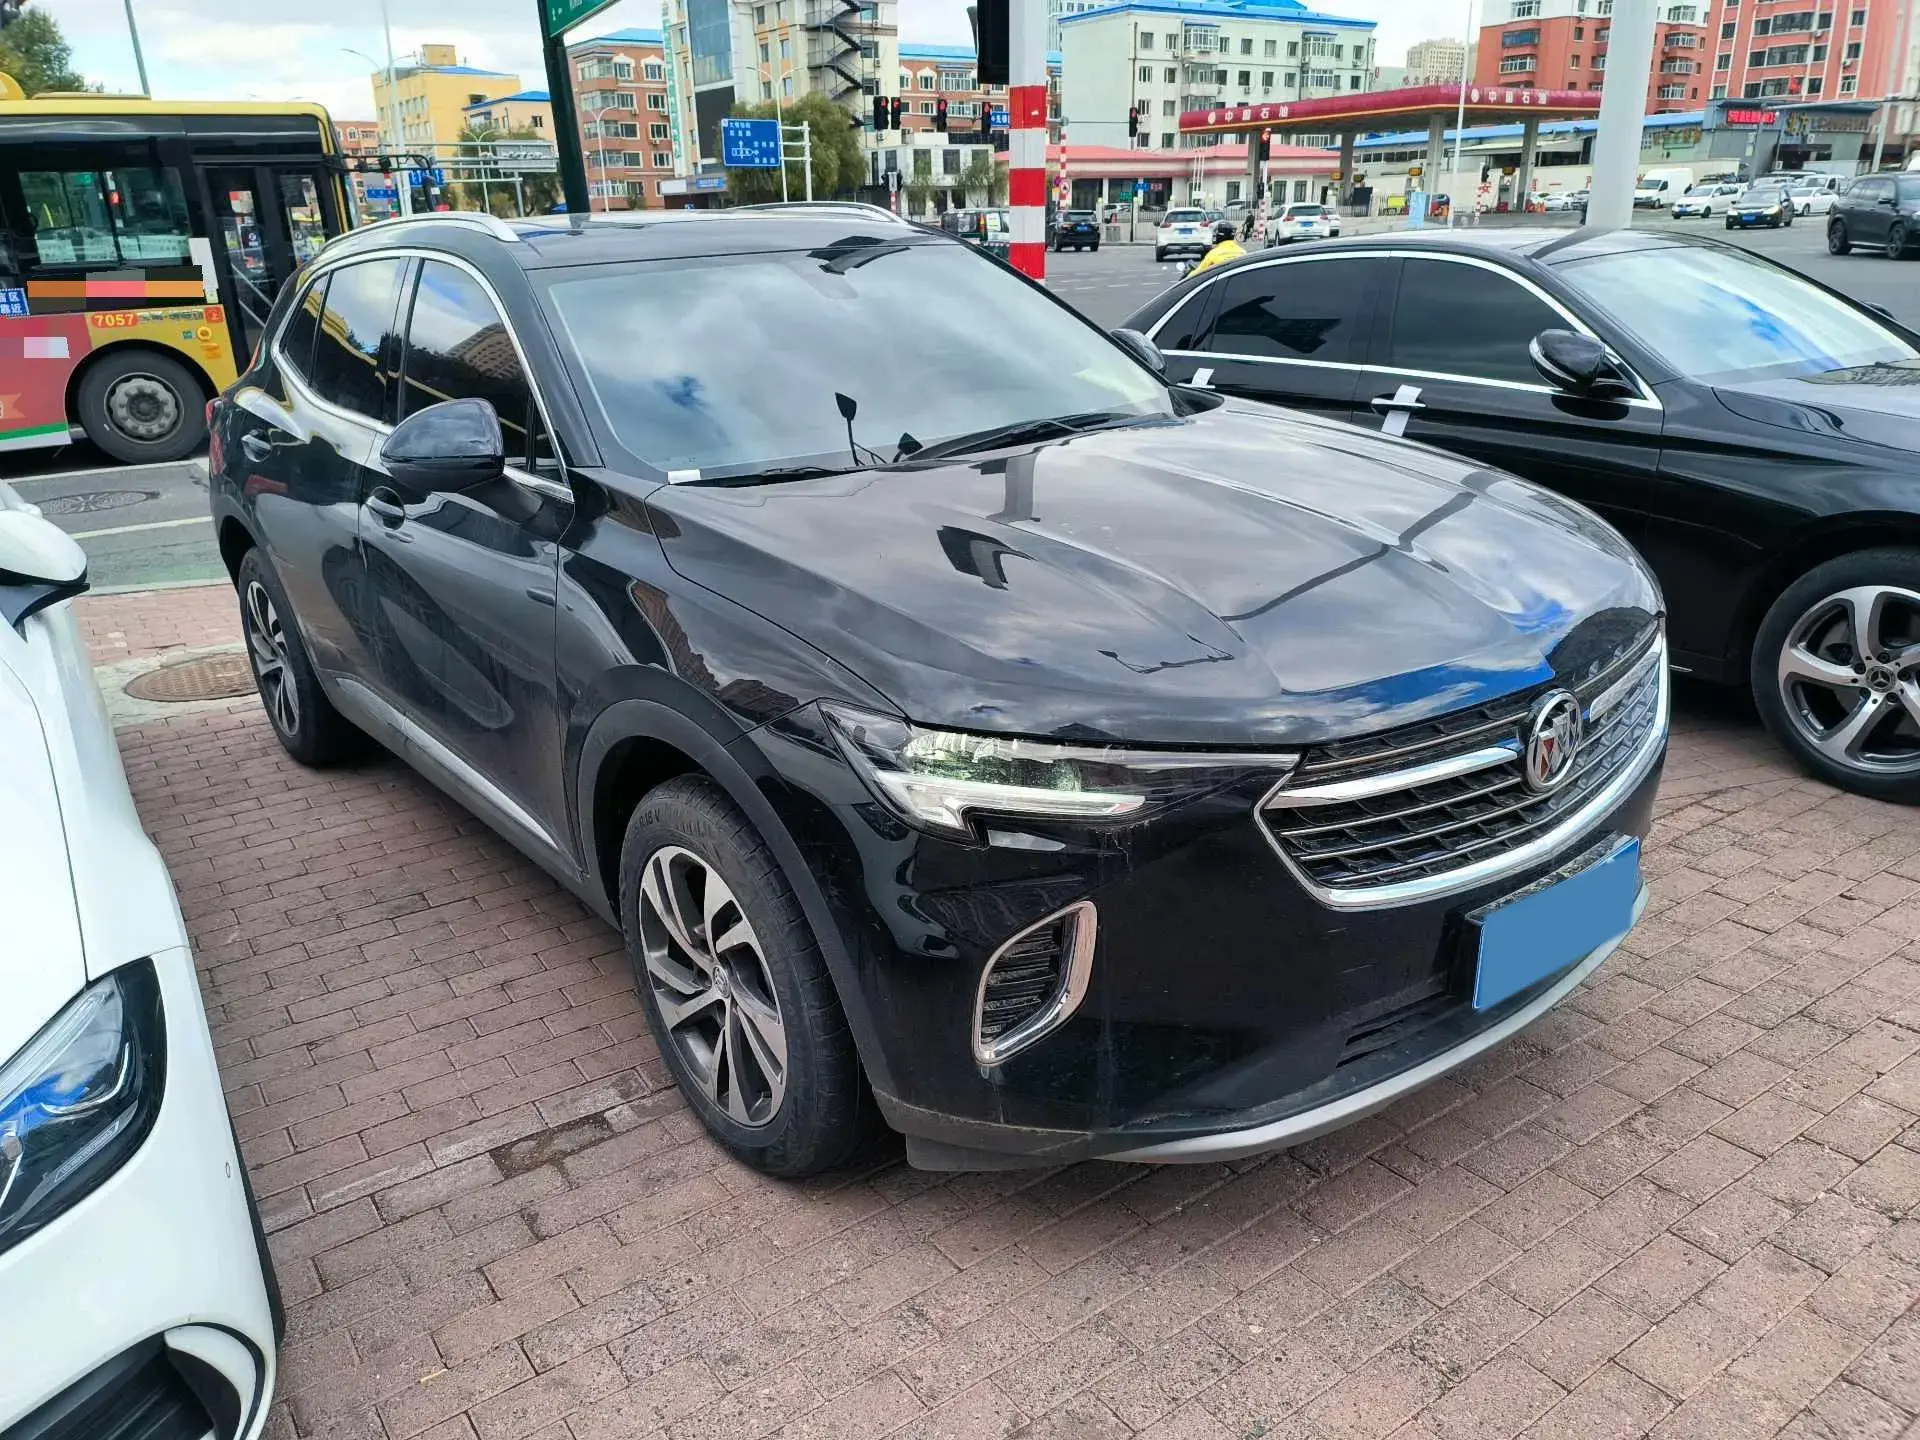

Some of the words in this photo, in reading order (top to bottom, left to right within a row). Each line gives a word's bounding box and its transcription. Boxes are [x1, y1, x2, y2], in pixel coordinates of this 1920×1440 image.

[1224, 104, 1289, 123] 中国石油
[94, 313, 134, 327] 7057
